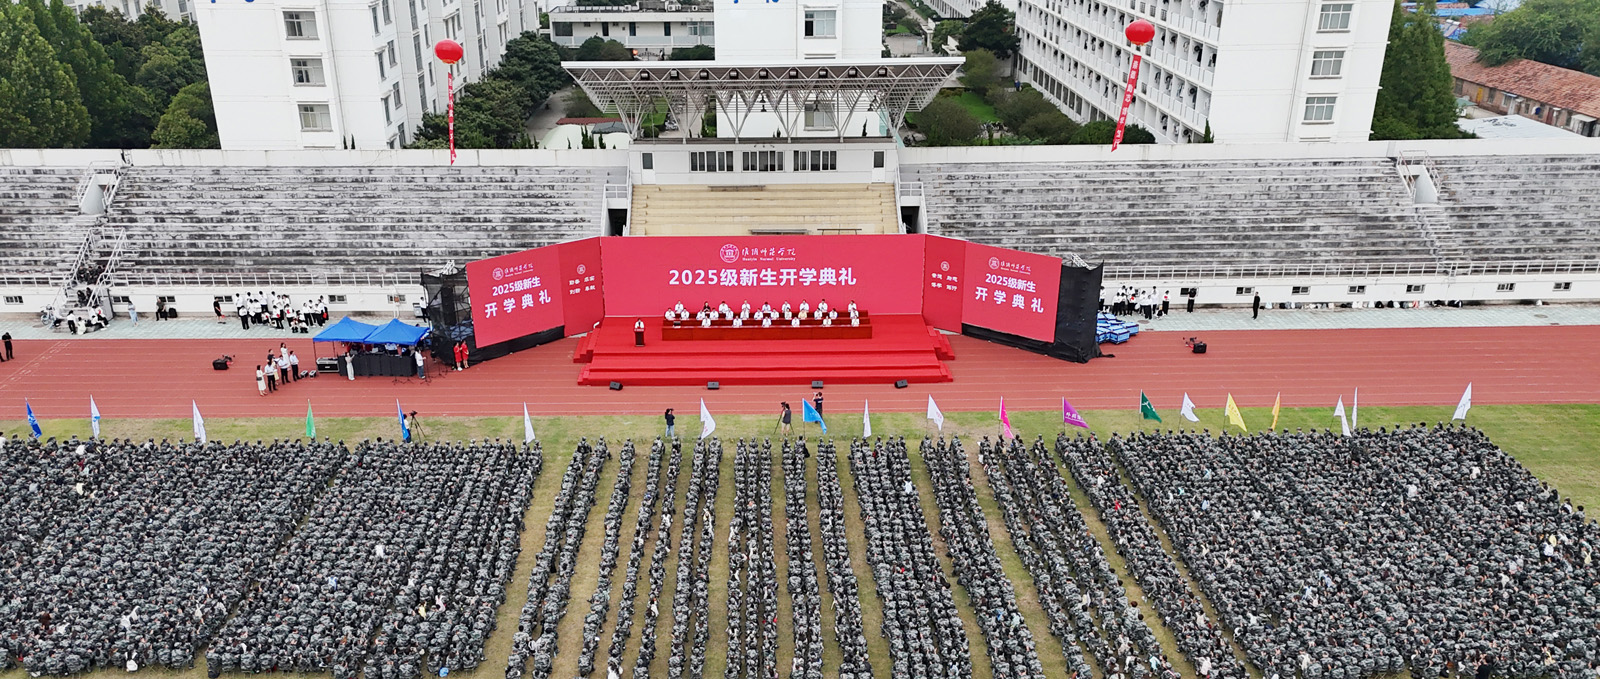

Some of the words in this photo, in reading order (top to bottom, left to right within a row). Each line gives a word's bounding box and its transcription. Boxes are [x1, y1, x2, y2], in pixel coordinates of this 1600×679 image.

[492, 276, 541, 296] 2025级新生
[669, 267, 857, 287] 2025级新生开学典礼
[985, 273, 1037, 293] 2025级新生
[484, 289, 552, 319] 开学典礼
[975, 286, 1044, 313] 开学典礼
